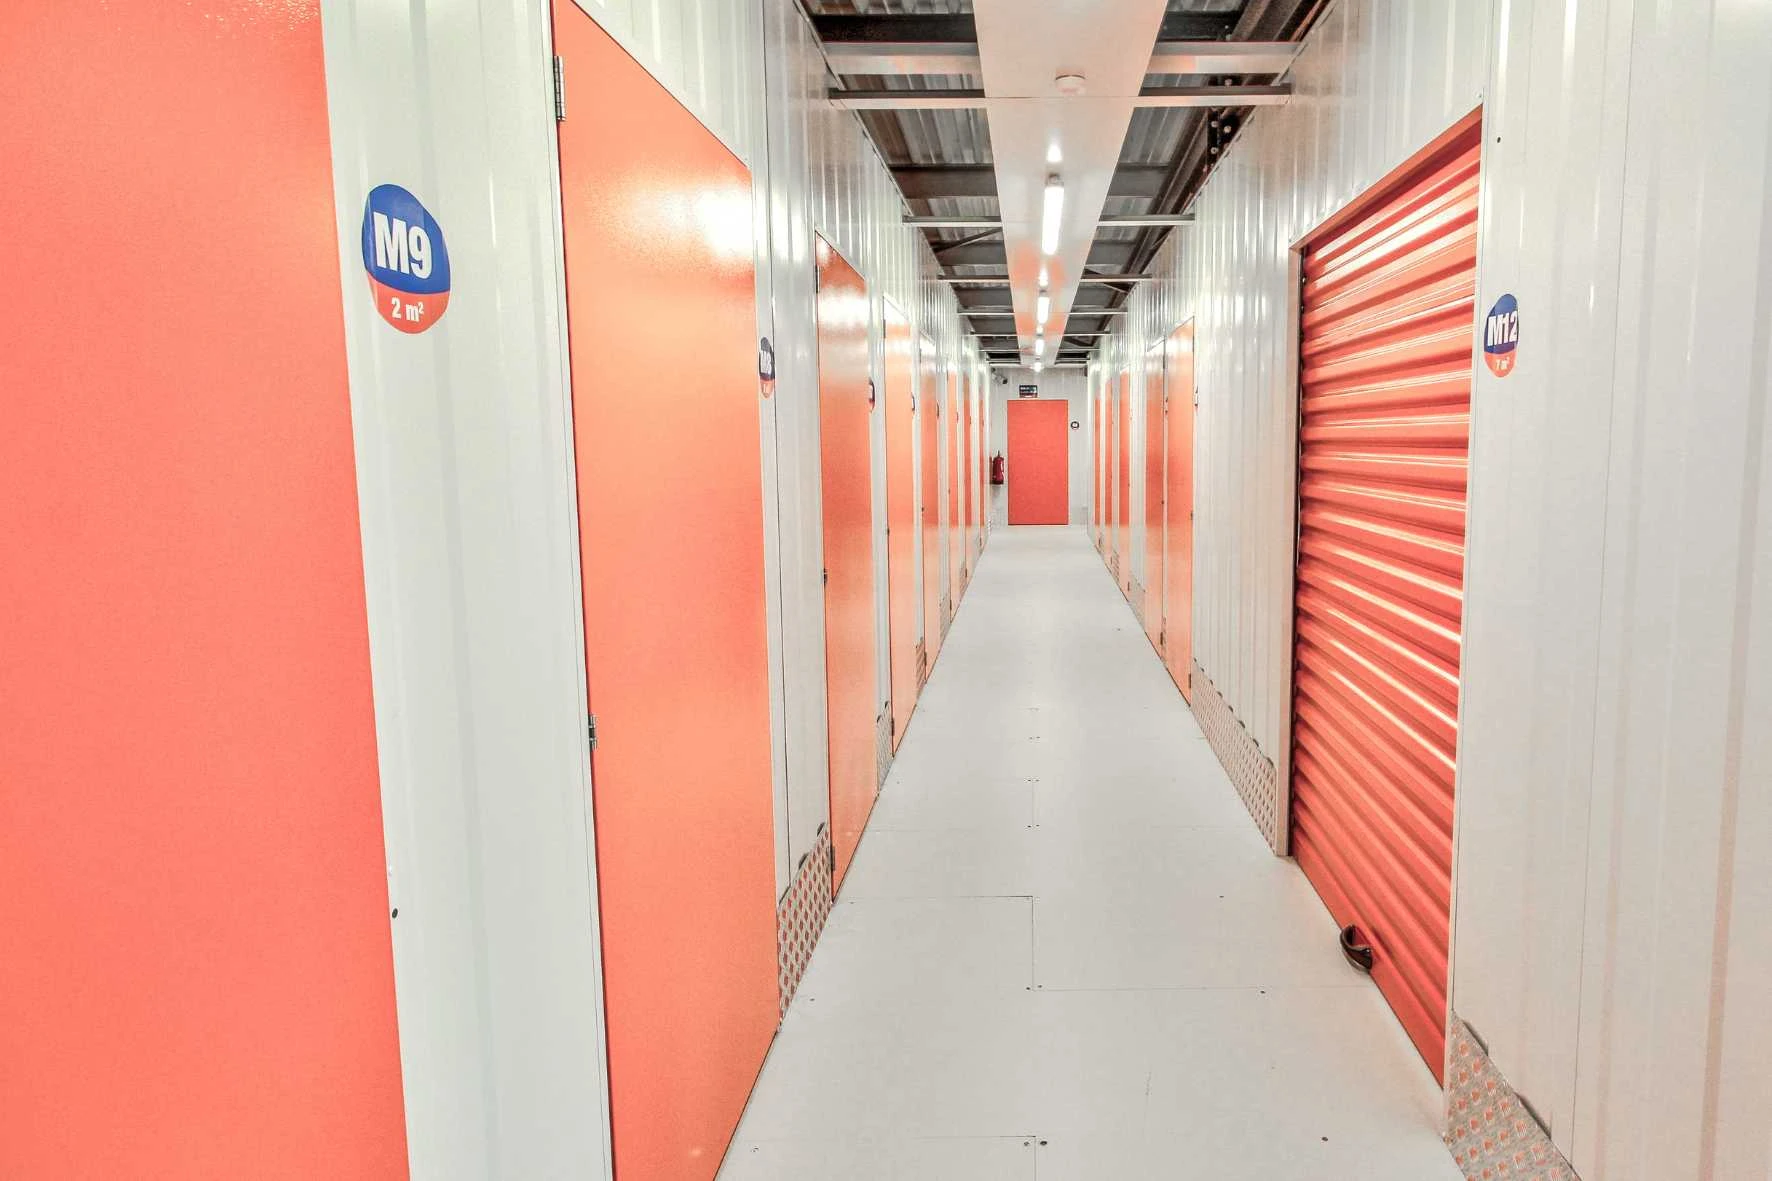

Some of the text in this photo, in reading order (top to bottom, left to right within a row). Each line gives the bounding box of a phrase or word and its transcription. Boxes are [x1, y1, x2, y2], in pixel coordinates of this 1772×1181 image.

[373, 211, 433, 280] M9
[391, 297, 401, 319] 2
[1487, 310, 1518, 347] M12
